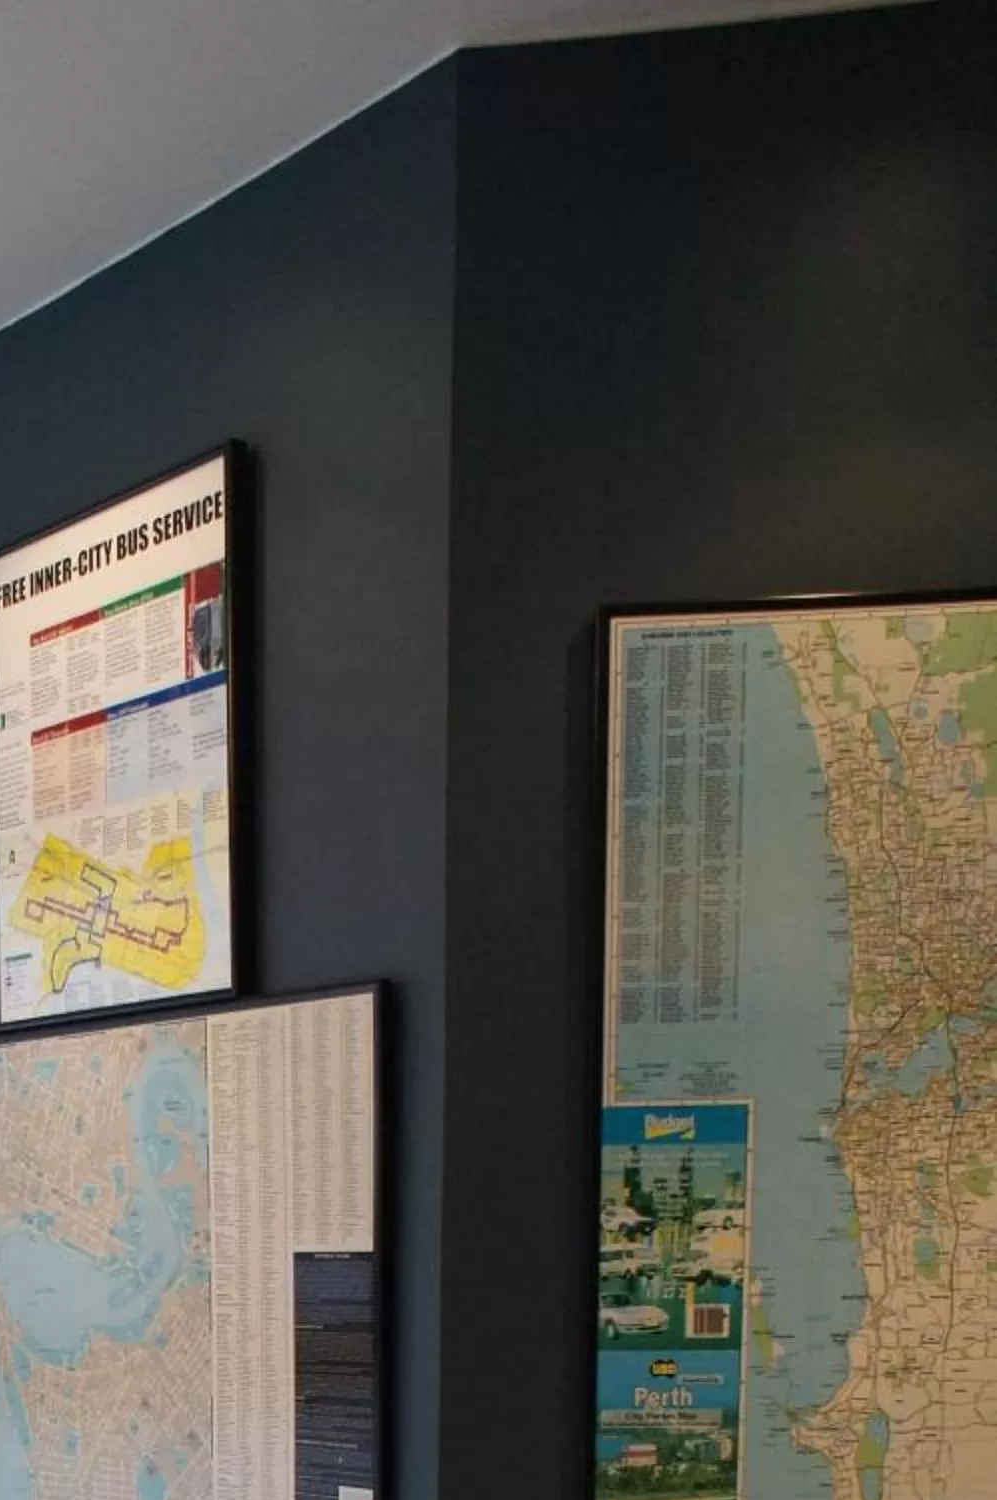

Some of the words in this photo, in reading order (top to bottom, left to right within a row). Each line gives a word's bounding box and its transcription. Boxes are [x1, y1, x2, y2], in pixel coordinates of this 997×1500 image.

[30, 538, 113, 597] INNER-CITY
[116, 523, 149, 560] BUS
[153, 489, 223, 545] SERVICE
[634, 1387, 693, 1408] Perth
